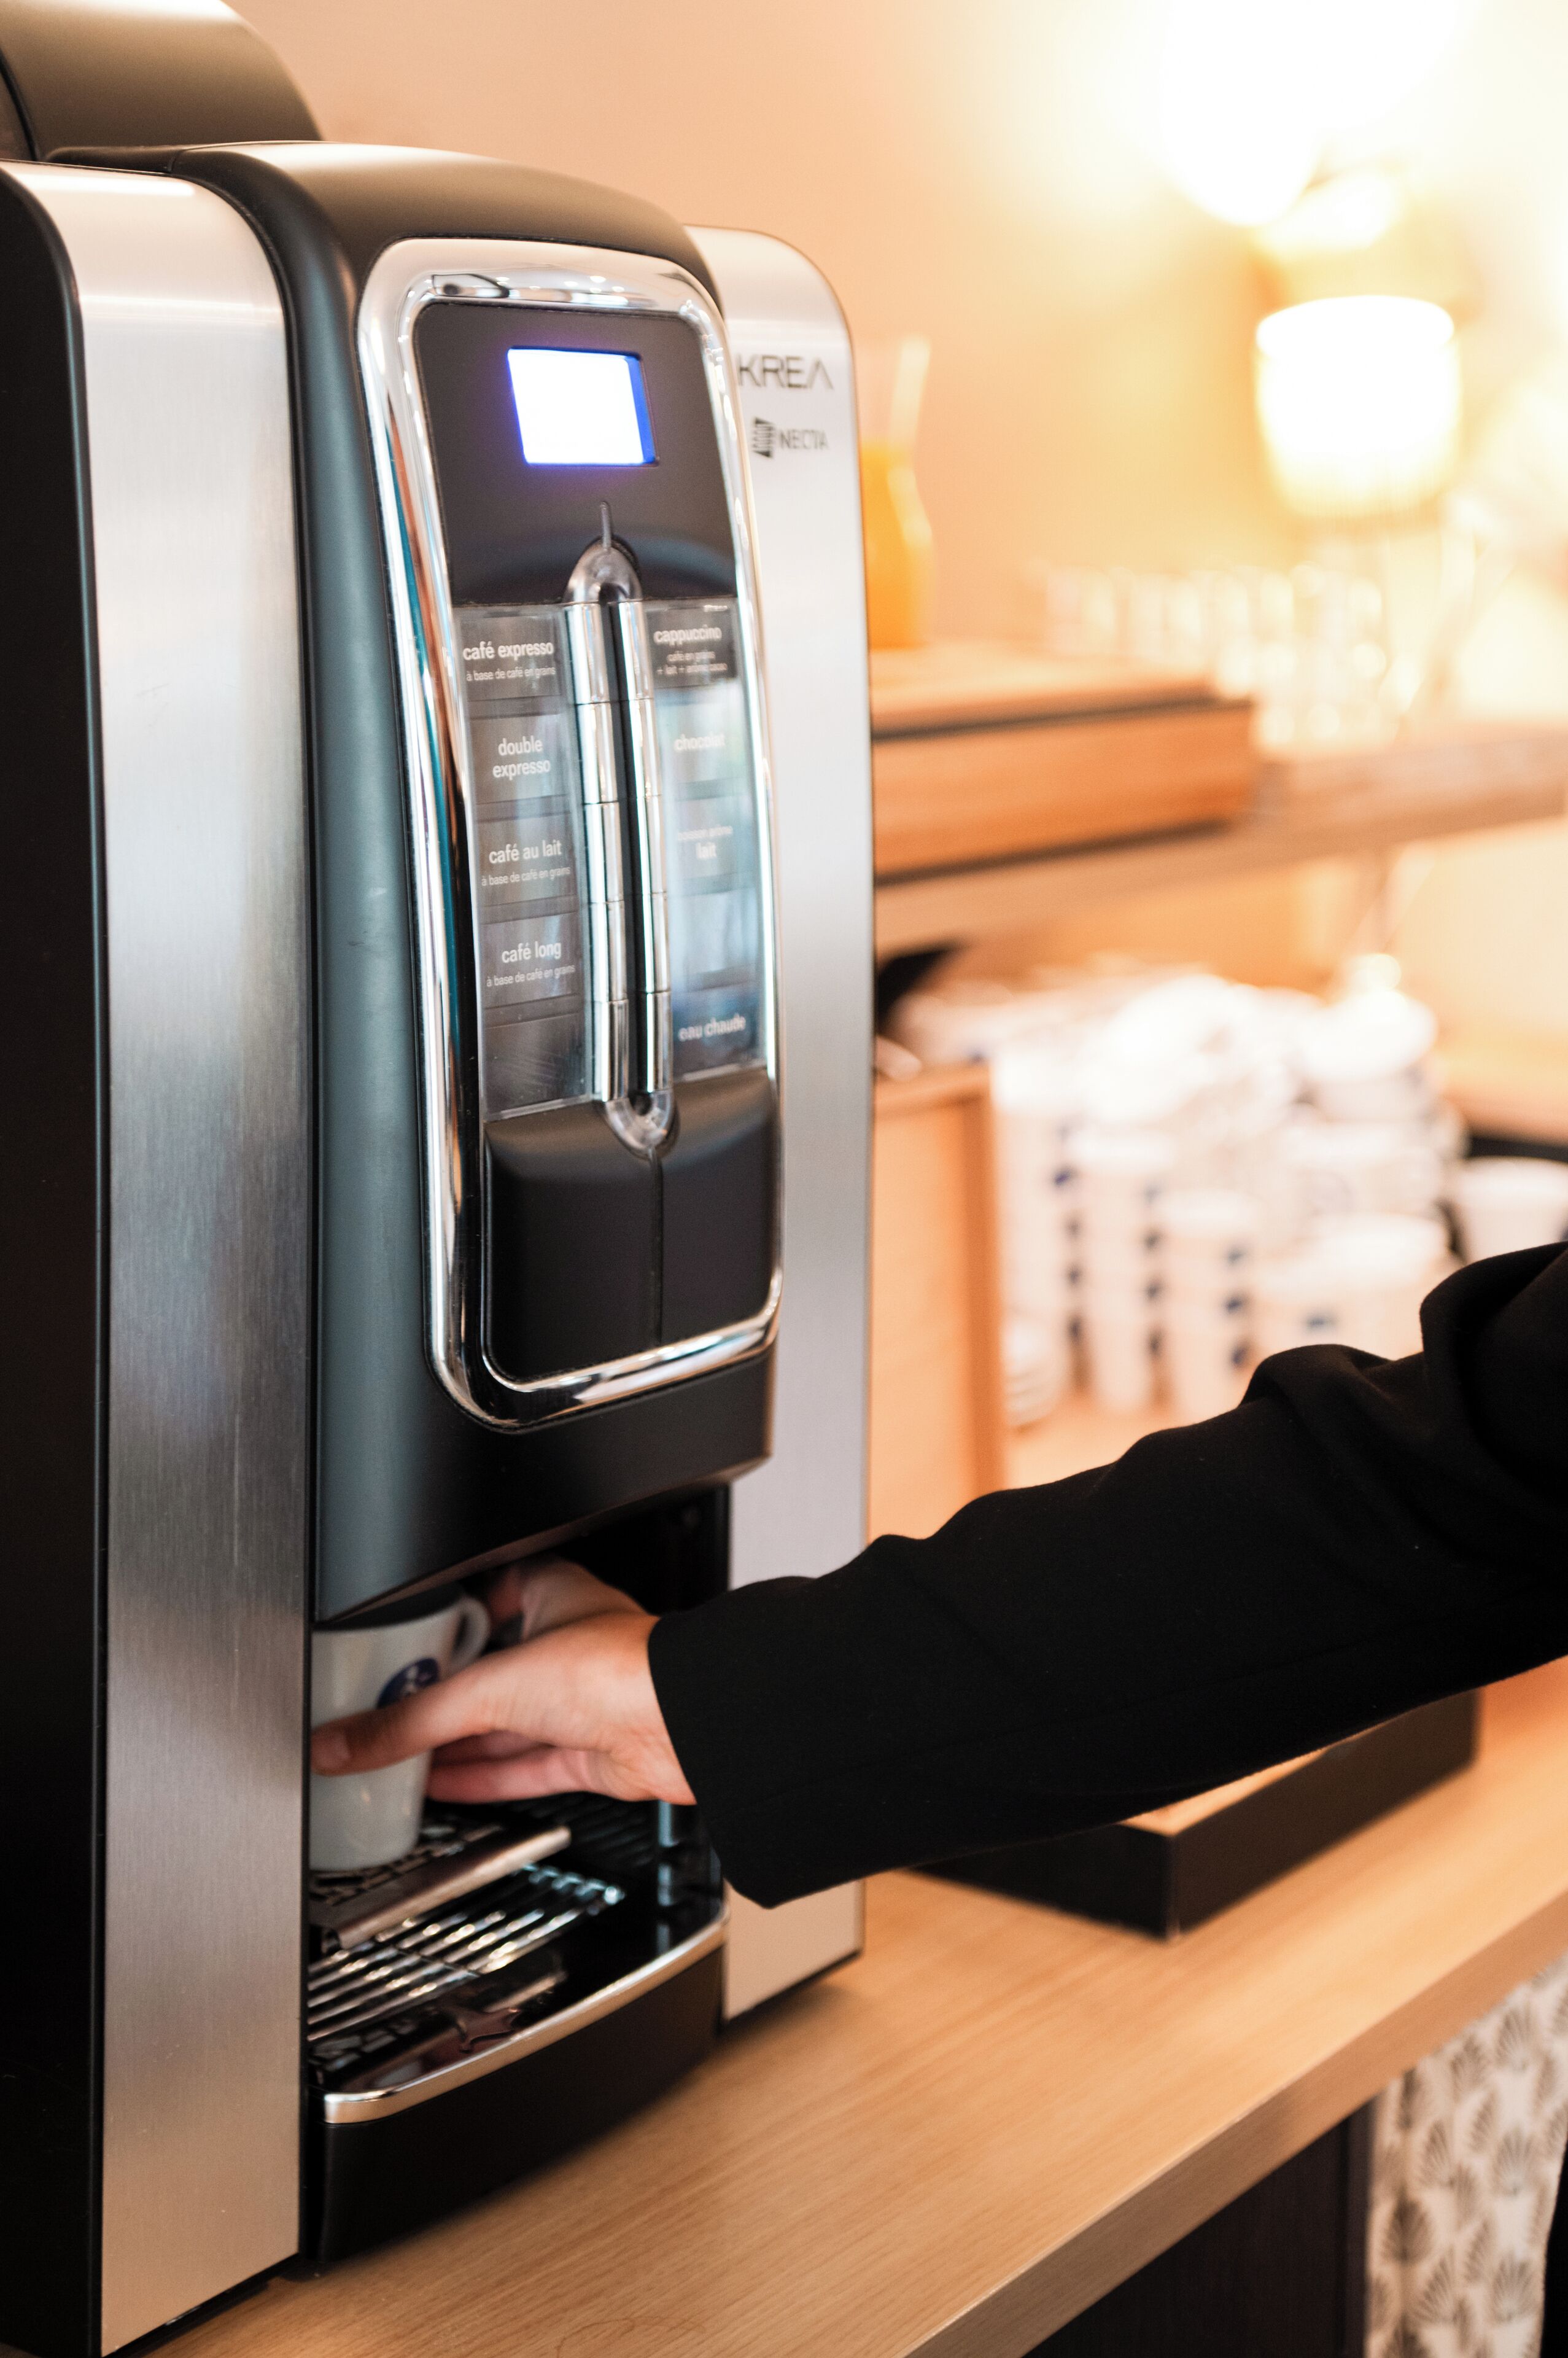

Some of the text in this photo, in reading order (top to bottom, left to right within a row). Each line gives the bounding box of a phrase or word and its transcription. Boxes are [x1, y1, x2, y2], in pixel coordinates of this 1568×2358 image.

[780, 429, 829, 449] NECTA
[463, 641, 554, 661] café expresso
[467, 671, 472, 682] à
[473, 671, 494, 681] base
[495, 669, 505, 679] de
[506, 666, 523, 678] café
[498, 735, 543, 756] double
[492, 760, 551, 780] expresso
[489, 839, 562, 864] café au lait
[481, 866, 571, 886] à base de café en grains
[502, 941, 562, 963] café long
[486, 976, 492, 987] à
[494, 975, 514, 986] base
[514, 971, 526, 982] de
[526, 968, 543, 981] café
[543, 969, 553, 978] en
[678, 1013, 747, 1042] eau chaude
